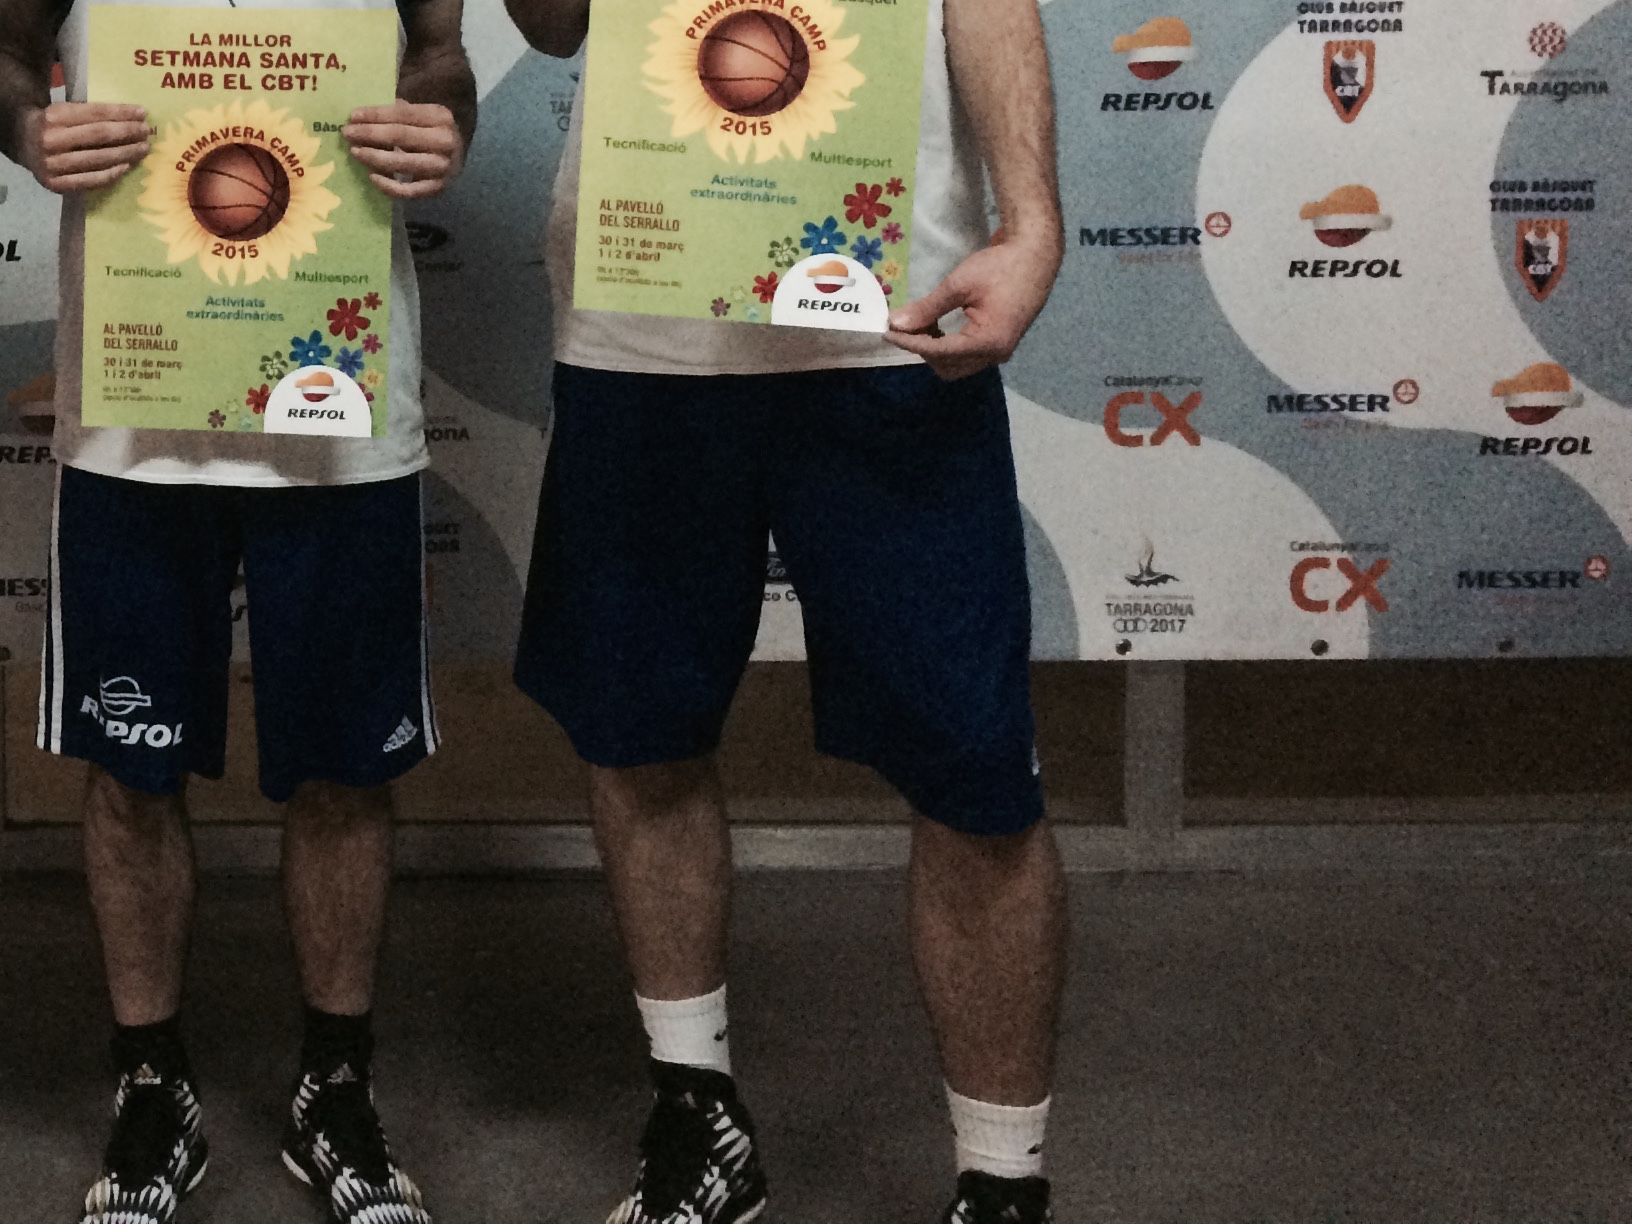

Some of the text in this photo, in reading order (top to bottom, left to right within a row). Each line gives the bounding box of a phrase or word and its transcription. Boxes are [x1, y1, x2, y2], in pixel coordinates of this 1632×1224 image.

[790, 5, 827, 52] CAMP
[189, 33, 292, 47] LA MILLOR
[134, 49, 347, 73] SETMANA SANTA,
[160, 72, 318, 91] AMB EL CBT!
[1101, 92, 1214, 112] REPSOL
[720, 117, 772, 136] 2015
[175, 126, 304, 178] PRIMAVERA CAMP
[603, 137, 687, 154] Tecnificació
[810, 151, 892, 169] Multiesport
[711, 174, 777, 189] Activitats
[690, 187, 797, 206] extraordinàries
[600, 200, 612, 211] AL
[599, 214, 680, 232] DEL SERRALLO
[599, 235, 612, 245] 30
[623, 236, 634, 247] 31
[640, 238, 652, 249] de
[656, 240, 684, 253] març
[1079, 227, 1201, 246] MESSER
[211, 243, 259, 260] 2015
[615, 250, 622, 259] 2
[104, 265, 182, 279] Tecnificació
[1289, 259, 1402, 278] REPSOL
[294, 271, 369, 286] Multiesport
[205, 296, 265, 308] Activitats
[798, 297, 861, 313] REPSOL
[186, 308, 284, 322] extraordinàries
[103, 323, 115, 334] AL
[103, 338, 178, 351] DEL SERRALLO
[1267, 393, 1390, 412] MESSER
[287, 408, 346, 420] REPSOL
[1103, 391, 1202, 447] CX
[1479, 436, 1591, 456] REPSOL
[1289, 557, 1390, 612] CX
[1106, 602, 1194, 617] TARRAGONA
[1151, 618, 1186, 633] 2017
